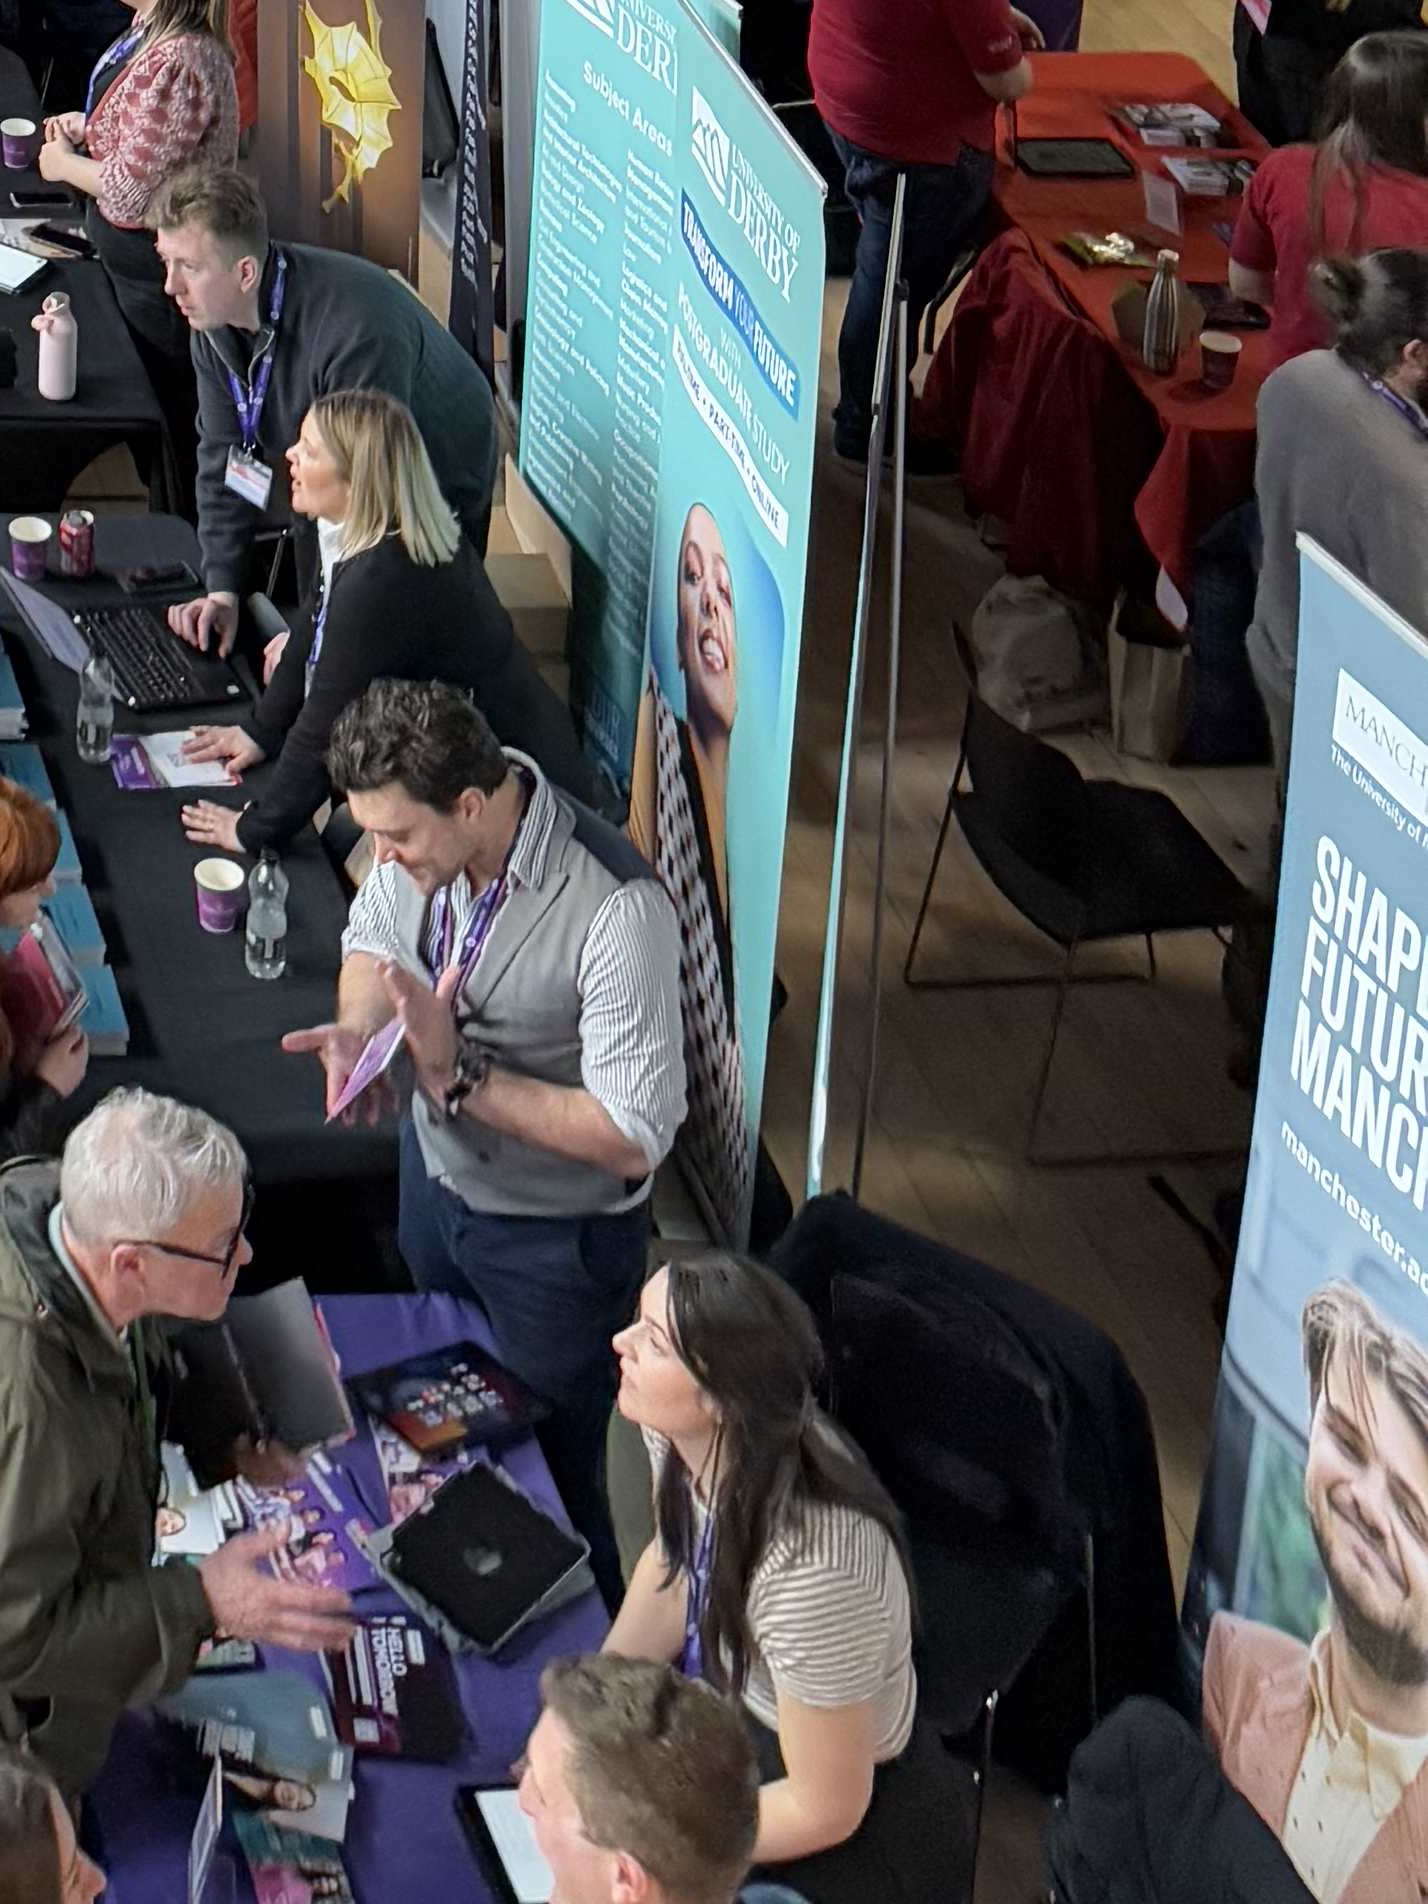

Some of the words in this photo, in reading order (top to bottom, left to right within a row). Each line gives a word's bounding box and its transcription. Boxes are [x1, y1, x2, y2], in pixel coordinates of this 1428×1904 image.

[584, 60, 630, 121] Subject
[632, 107, 673, 157] Areas
[727, 184, 799, 304] DERBY
[731, 145, 782, 235] UNIVERSITY
[784, 223, 801, 252] OF
[683, 200, 734, 310] TRANSFORM
[754, 328, 795, 405] FUTURE
[678, 280, 752, 417] POSTGRADUATE
[752, 414, 791, 484] STUDY
[751, 476, 780, 533] ONLINE
[1332, 744, 1349, 777] The
[1350, 760, 1406, 834] University
[1408, 819, 1422, 845] of
